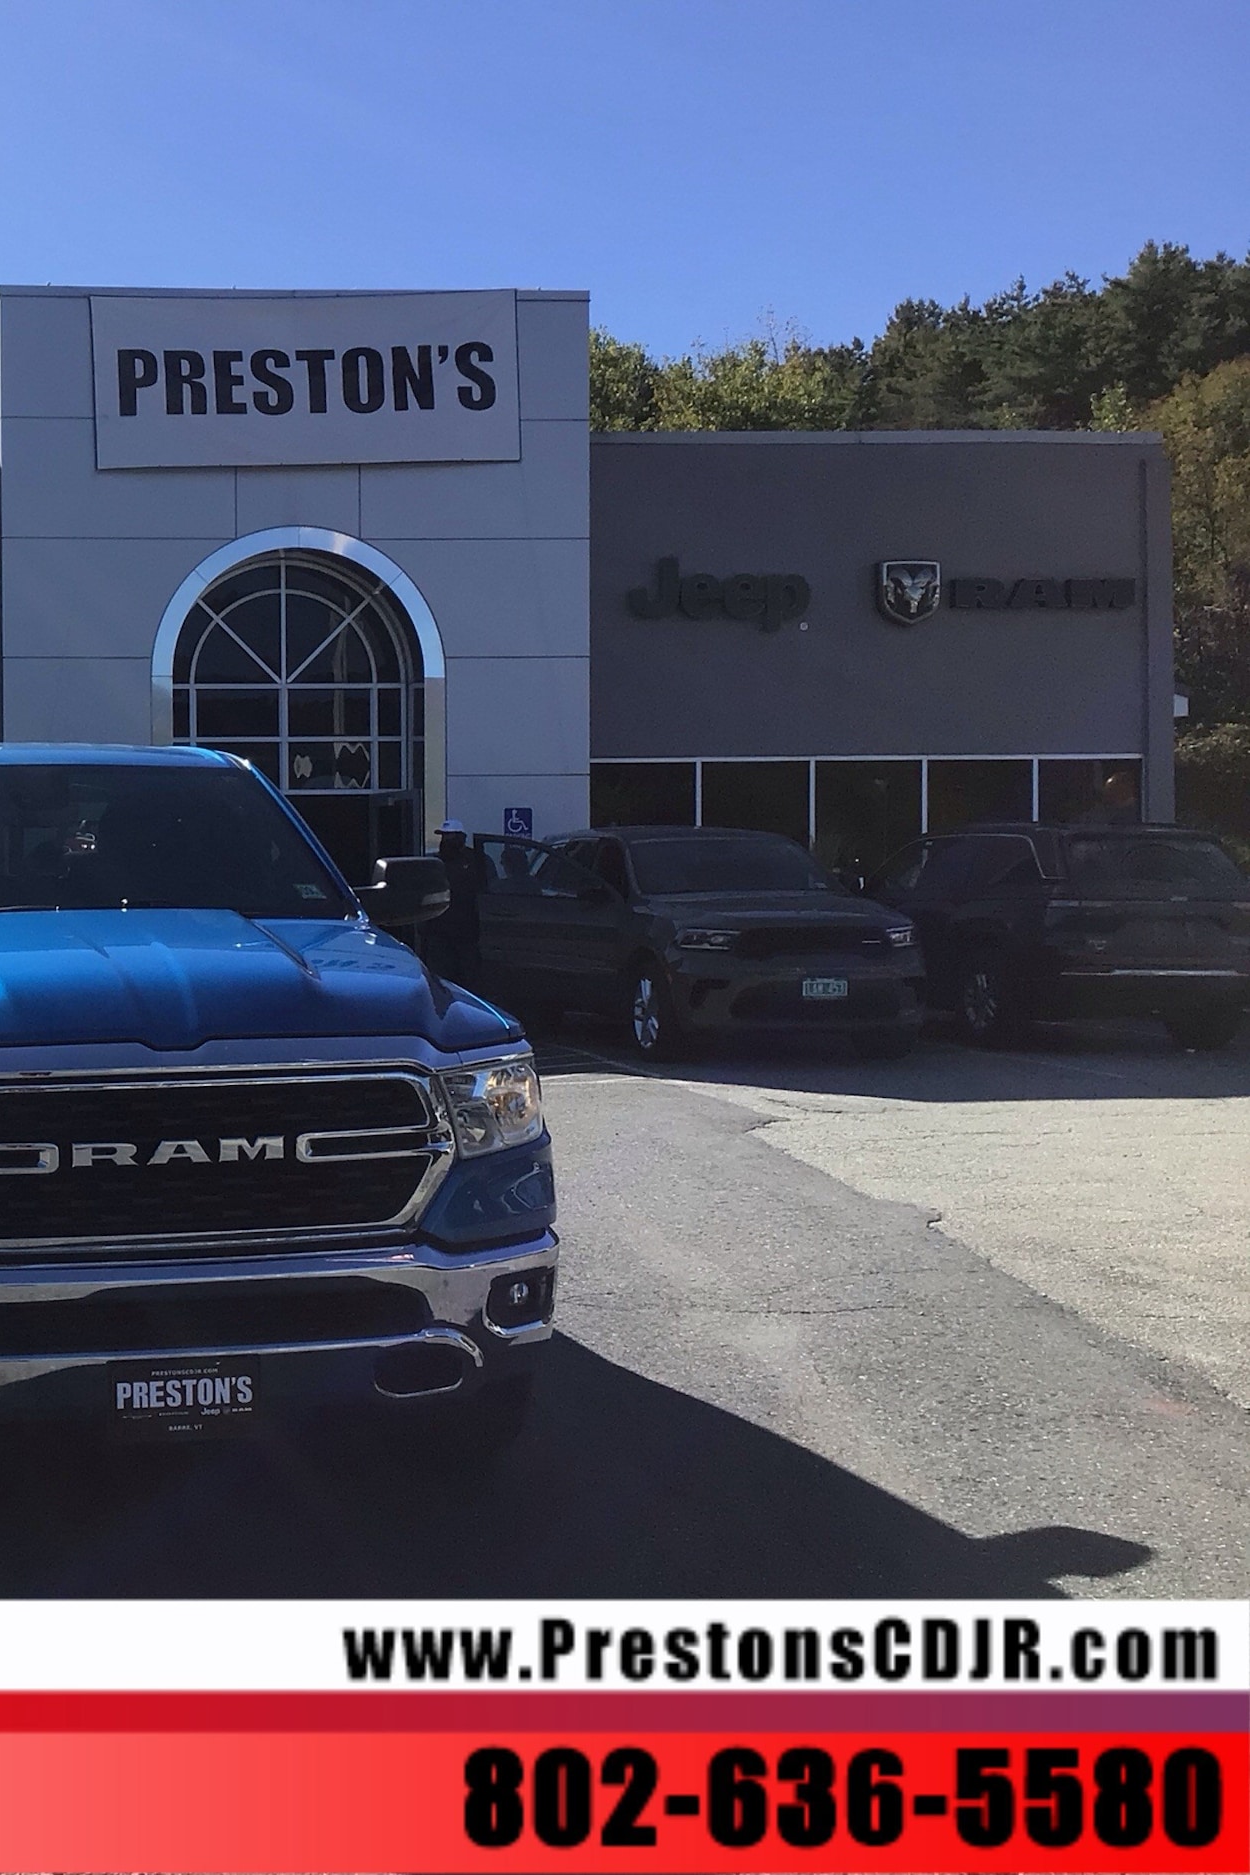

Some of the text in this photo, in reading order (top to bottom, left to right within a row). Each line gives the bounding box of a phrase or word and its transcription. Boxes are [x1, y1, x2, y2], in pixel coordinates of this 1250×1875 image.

[117, 341, 497, 417] PRESTON'S
[625, 555, 812, 633] Jeep
[950, 576, 1137, 609] RAM
[72, 1135, 286, 1168] RAM
[117, 1376, 253, 1410] PRESTON'S
[200, 1407, 220, 1416] Jeep
